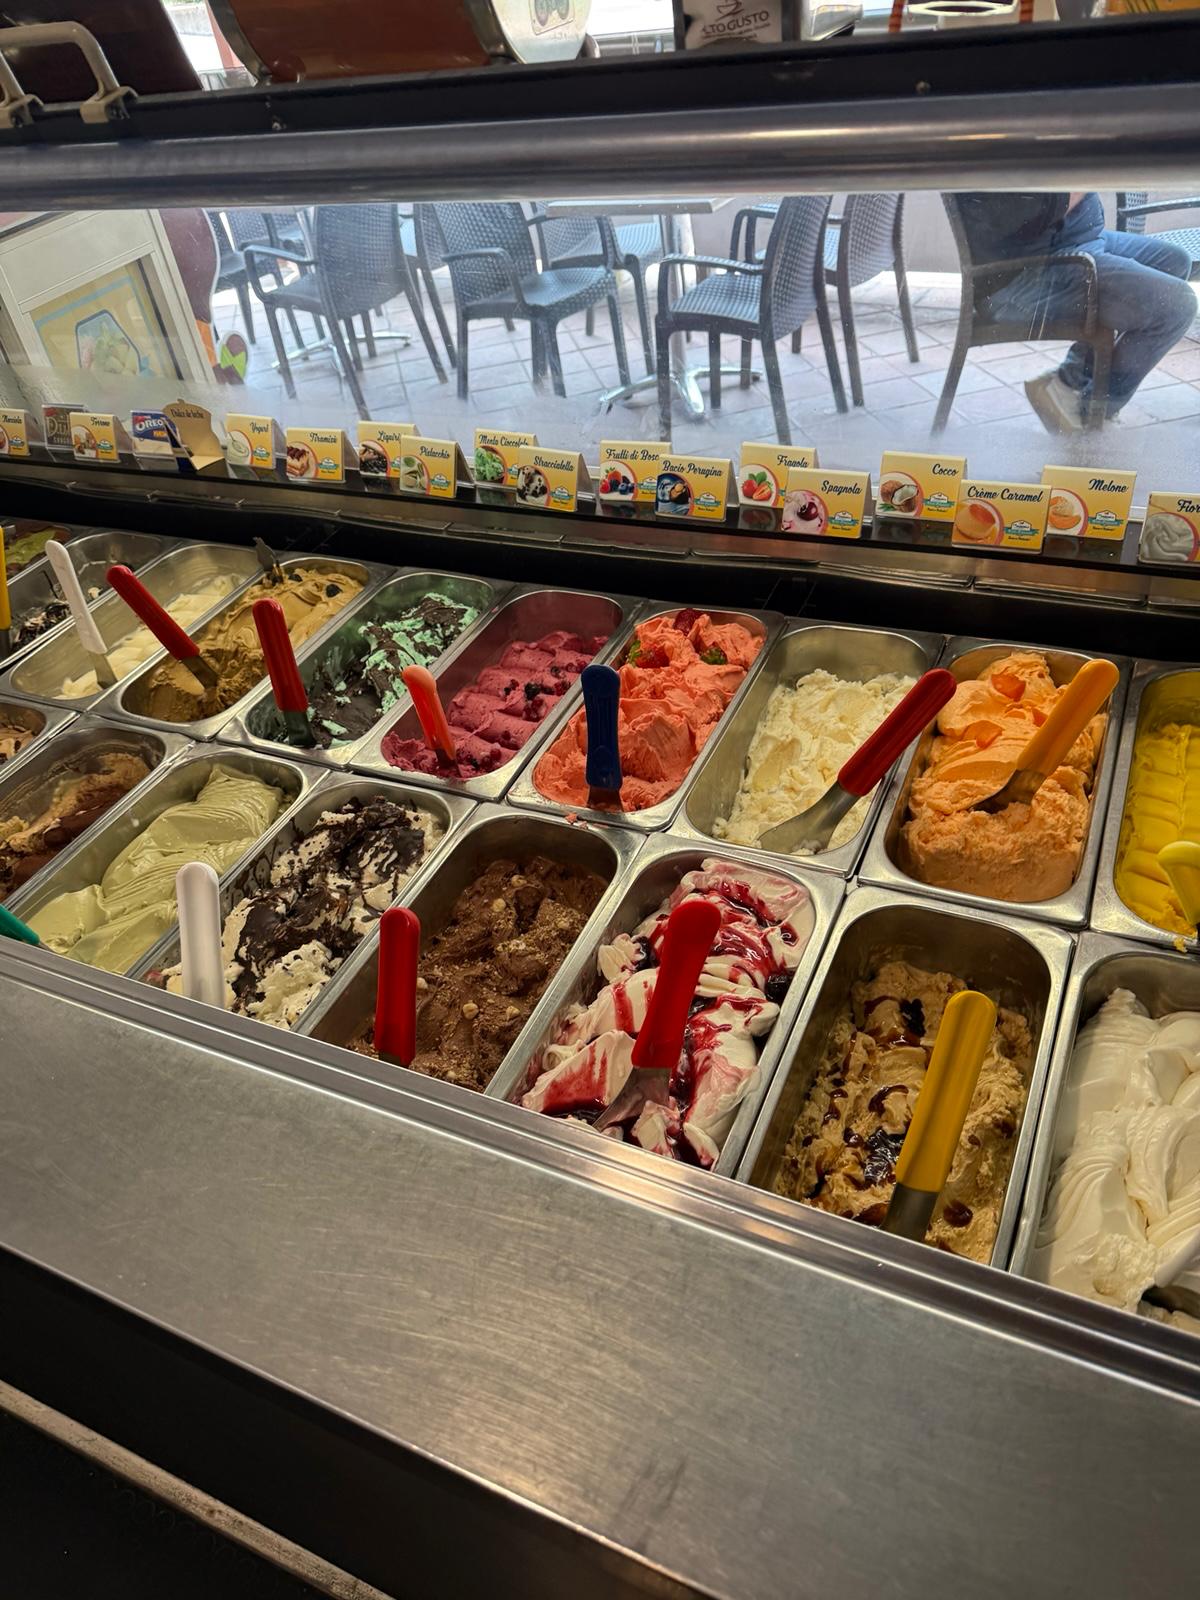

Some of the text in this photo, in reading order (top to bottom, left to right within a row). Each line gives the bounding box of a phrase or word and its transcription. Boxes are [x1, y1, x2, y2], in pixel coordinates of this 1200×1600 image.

[136, 419, 164, 431] OREO
[479, 434, 499, 445] Menta
[606, 448, 660, 461] Frutti di Bosc
[777, 454, 809, 468] Fragola
[534, 456, 575, 471] Stracciatella
[662, 460, 722, 478] Bacio Perugina
[932, 463, 959, 476] Cocco
[821, 480, 862, 495] Spagnola
[1088, 478, 1129, 493] Melone
[967, 486, 1043, 503] Crème Caramel
